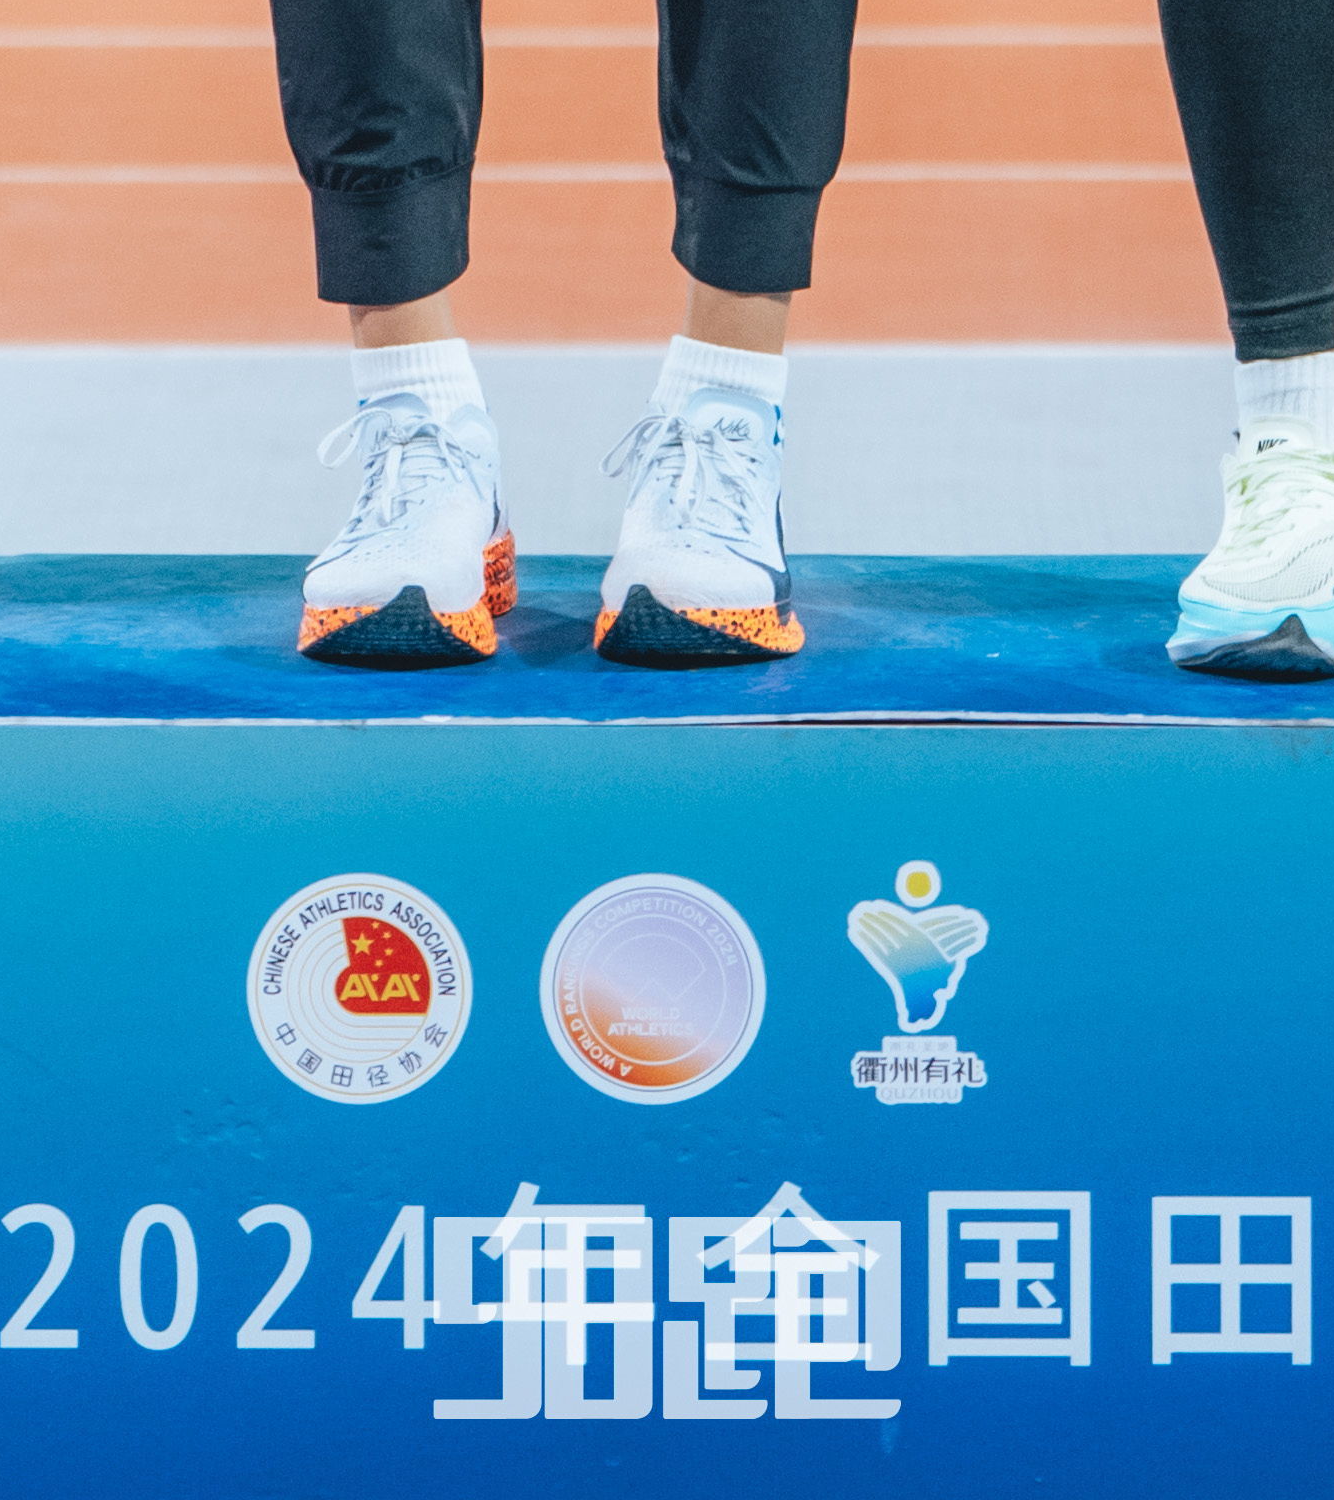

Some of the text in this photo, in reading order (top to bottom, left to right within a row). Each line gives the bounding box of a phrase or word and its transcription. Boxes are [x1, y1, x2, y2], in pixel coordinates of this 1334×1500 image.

[263, 890, 457, 997] CHINESE ATHLETICS ASSOCIATION
[570, 1017, 615, 1071] WORLD
[594, 896, 709, 930] COMPETITION
[274, 1021, 449, 1088] 中国田径协会
[856, 1055, 984, 1084] 衢州有礼
